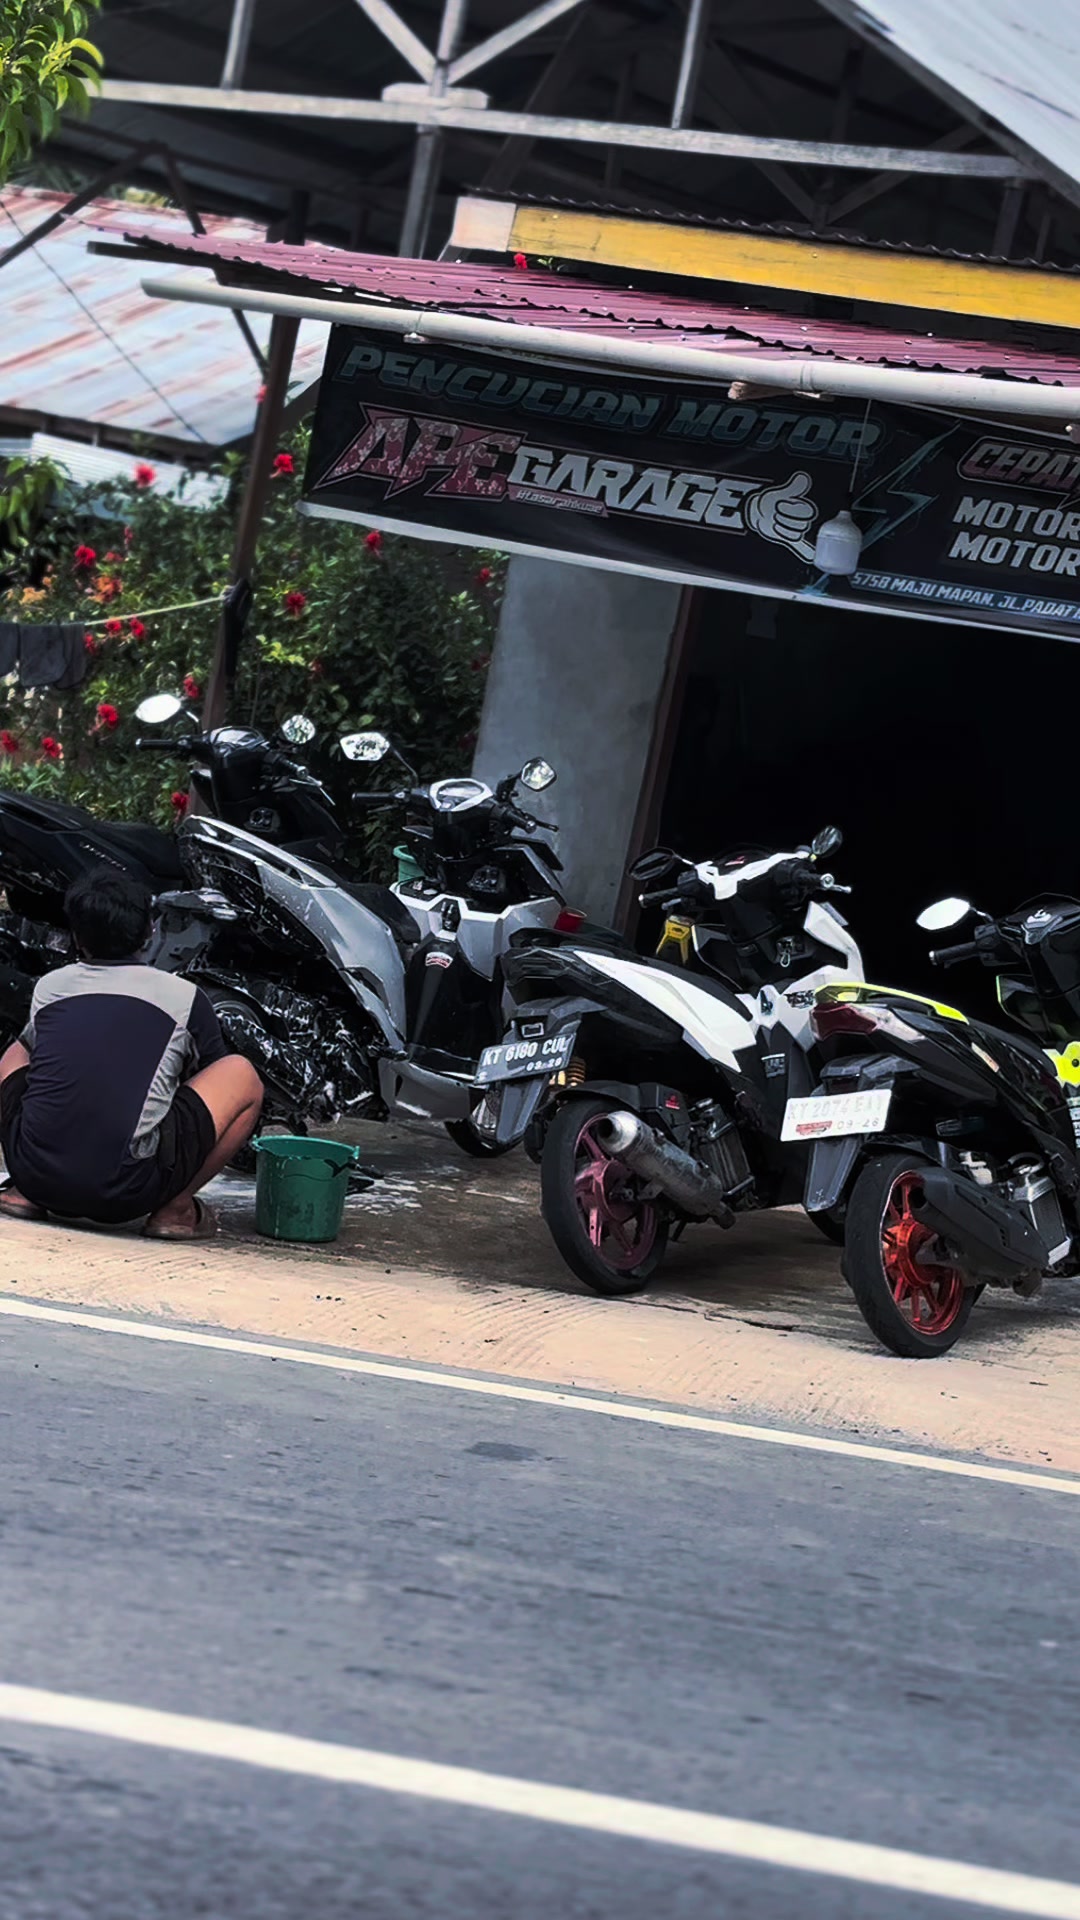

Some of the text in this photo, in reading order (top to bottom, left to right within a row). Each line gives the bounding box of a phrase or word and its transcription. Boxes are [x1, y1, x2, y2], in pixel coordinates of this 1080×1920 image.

[338, 345, 882, 459] PENCUCIAN MOTOR
[320, 406, 762, 530] APE GARAGE
[953, 496, 1080, 541] MOTOR
[948, 531, 1080, 577] MOTOR
[889, 578, 936, 598] MAJU
[482, 1048, 503, 1067] KT
